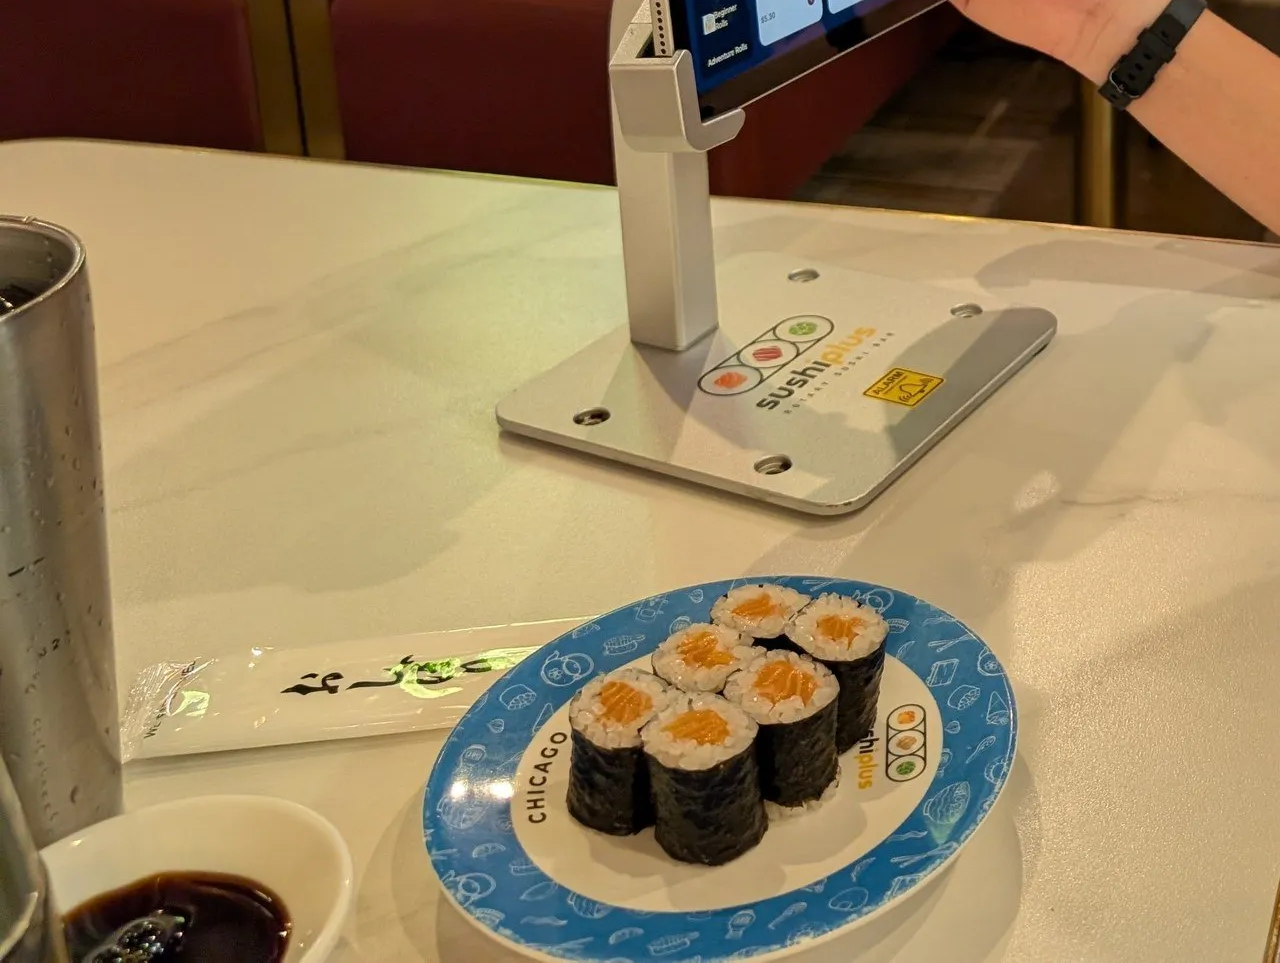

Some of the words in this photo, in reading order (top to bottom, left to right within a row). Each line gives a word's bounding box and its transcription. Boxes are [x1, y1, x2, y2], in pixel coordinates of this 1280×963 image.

[713, 4, 738, 19] Beginner
[714, 19, 729, 30] Rolls
[707, 49, 735, 68] Adventure
[735, 43, 748, 55] Rolls
[784, 381, 829, 415] ROTARY
[834, 351, 869, 377] SUSHI
[872, 332, 895, 348] BAR
[872, 371, 904, 396] ALARM
[526, 732, 568, 824] CHICAGO
